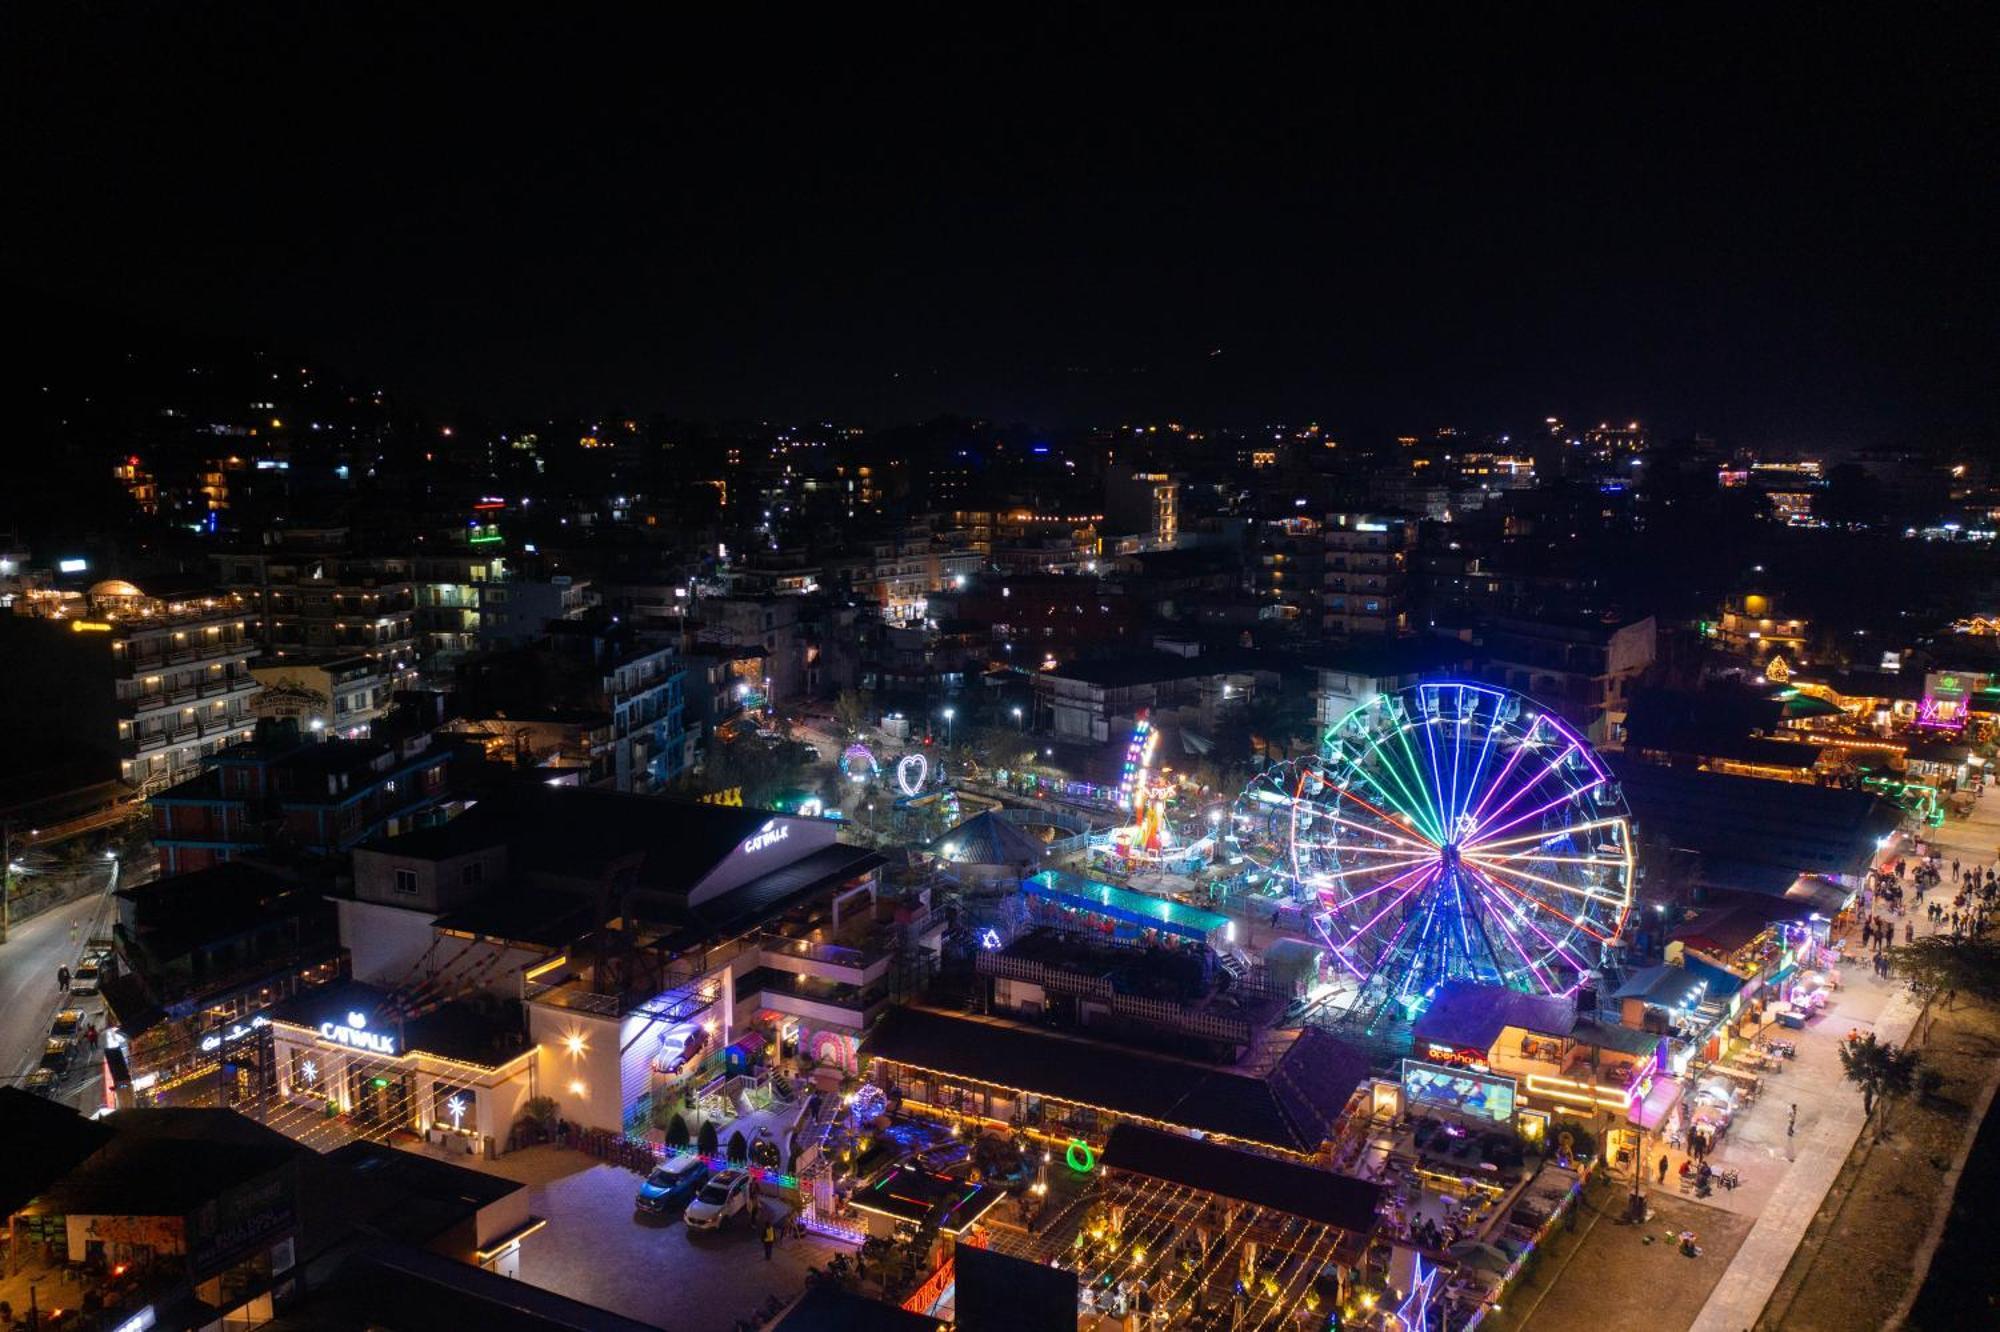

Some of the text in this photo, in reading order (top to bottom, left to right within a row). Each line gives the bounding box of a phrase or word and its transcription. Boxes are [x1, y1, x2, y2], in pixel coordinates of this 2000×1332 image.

[275, 707, 301, 716] CLINIC
[744, 825, 789, 854] CATWALK
[320, 1022, 395, 1054] CATWALK
